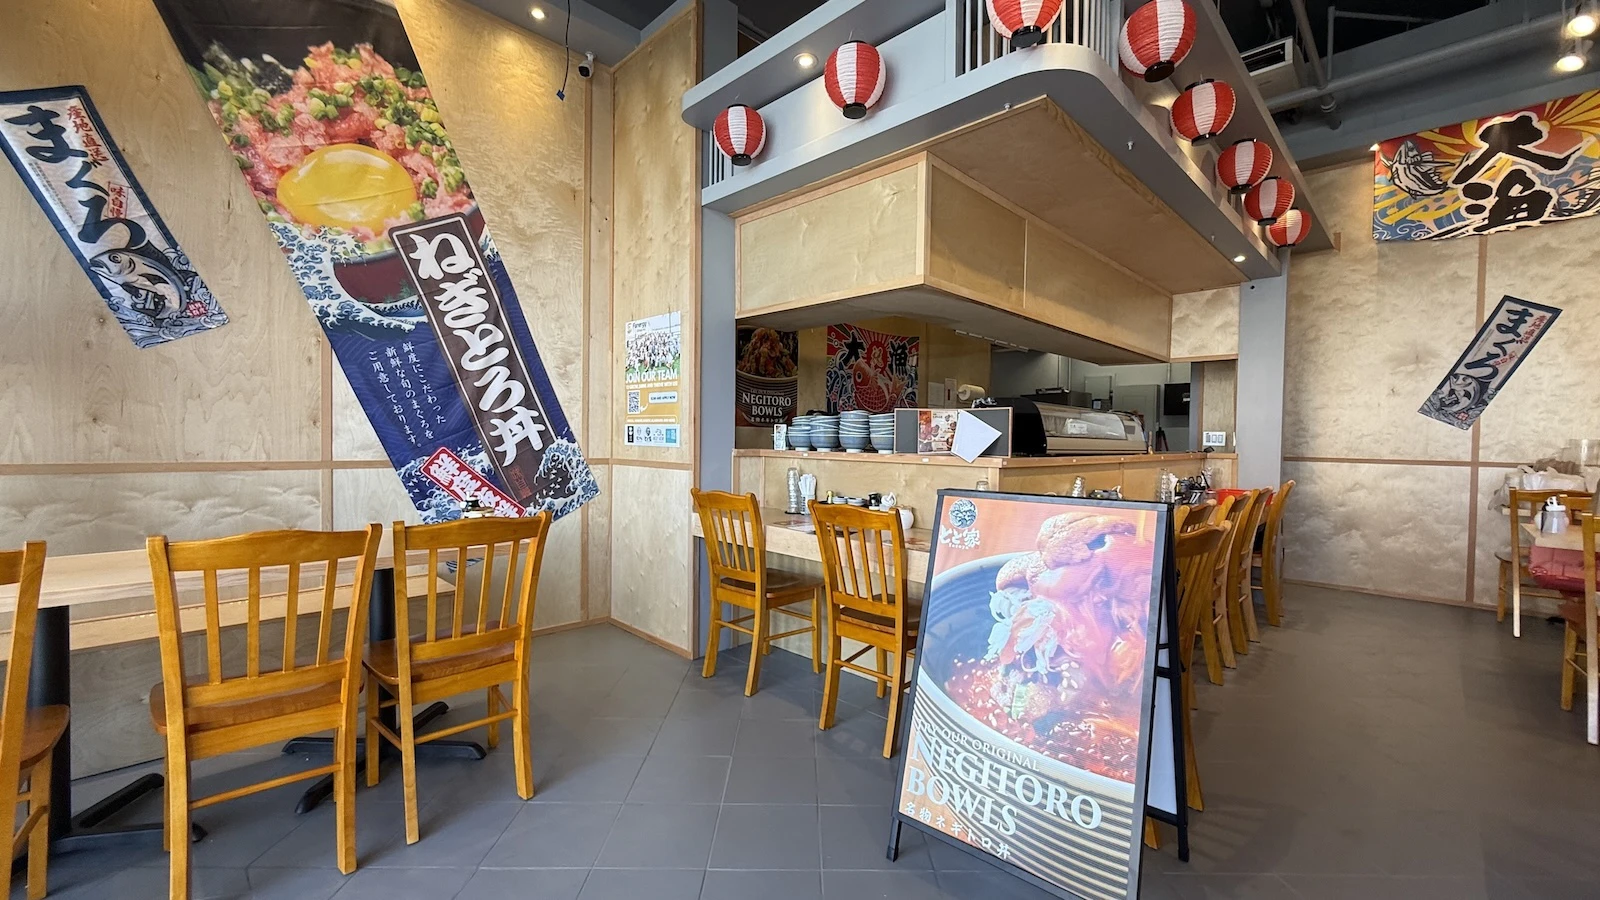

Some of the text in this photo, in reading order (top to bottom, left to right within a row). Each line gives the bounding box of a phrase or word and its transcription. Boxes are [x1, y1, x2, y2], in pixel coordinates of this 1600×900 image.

[4, 105, 147, 248] まぐろ
[409, 232, 545, 467] ねぎとろ丼
[626, 368, 678, 384] JOIN OUR TEAM
[1464, 308, 1534, 381] まぐろ
[369, 350, 422, 448] ご用意しております。
[385, 346, 434, 439] 新鮮な旬のまぐろを
[402, 341, 446, 424] 鮮度にこだわった
[742, 392, 792, 406] NEGITORO
[751, 405, 783, 417] BOWLS
[940, 525, 980, 548] とと家
[910, 731, 1102, 830] NEGITORO
[942, 727, 968, 746] OUR
[972, 739, 1040, 772] ORIGINAL
[905, 801, 1011, 860] 名物ネギトロ丼
[906, 764, 1018, 836] BOWLS
